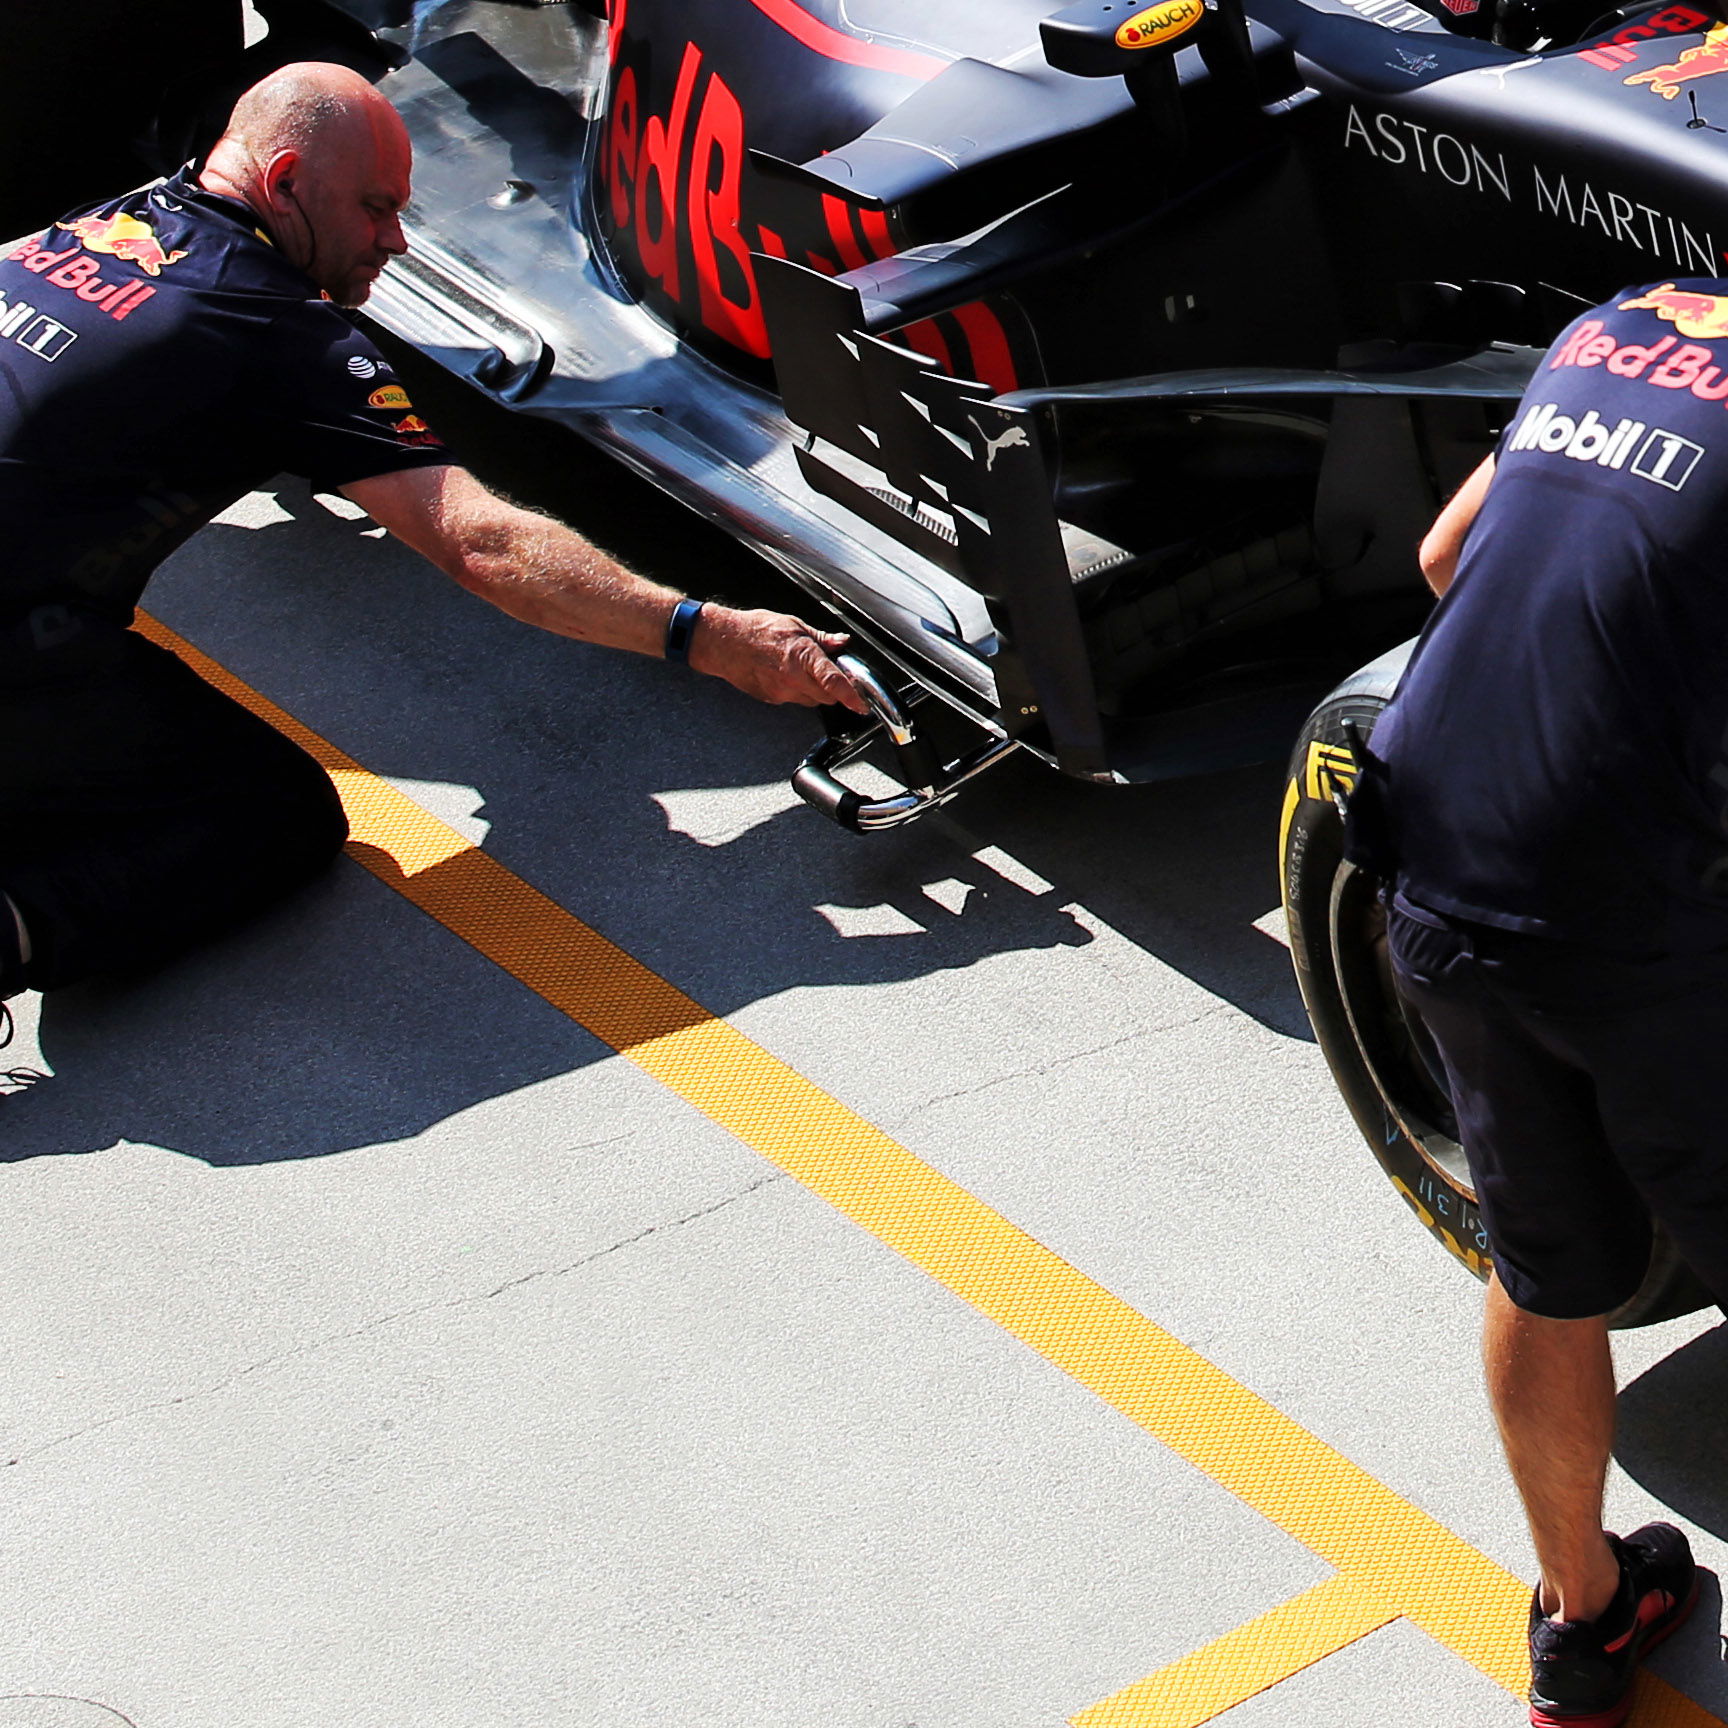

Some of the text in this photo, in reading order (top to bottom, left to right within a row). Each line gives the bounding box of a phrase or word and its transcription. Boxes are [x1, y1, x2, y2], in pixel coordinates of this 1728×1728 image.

[1138, 1, 1196, 40] RAUCH
[1344, 104, 1719, 280] ASTON MARTIN
[1508, 401, 1647, 471] Mobil
